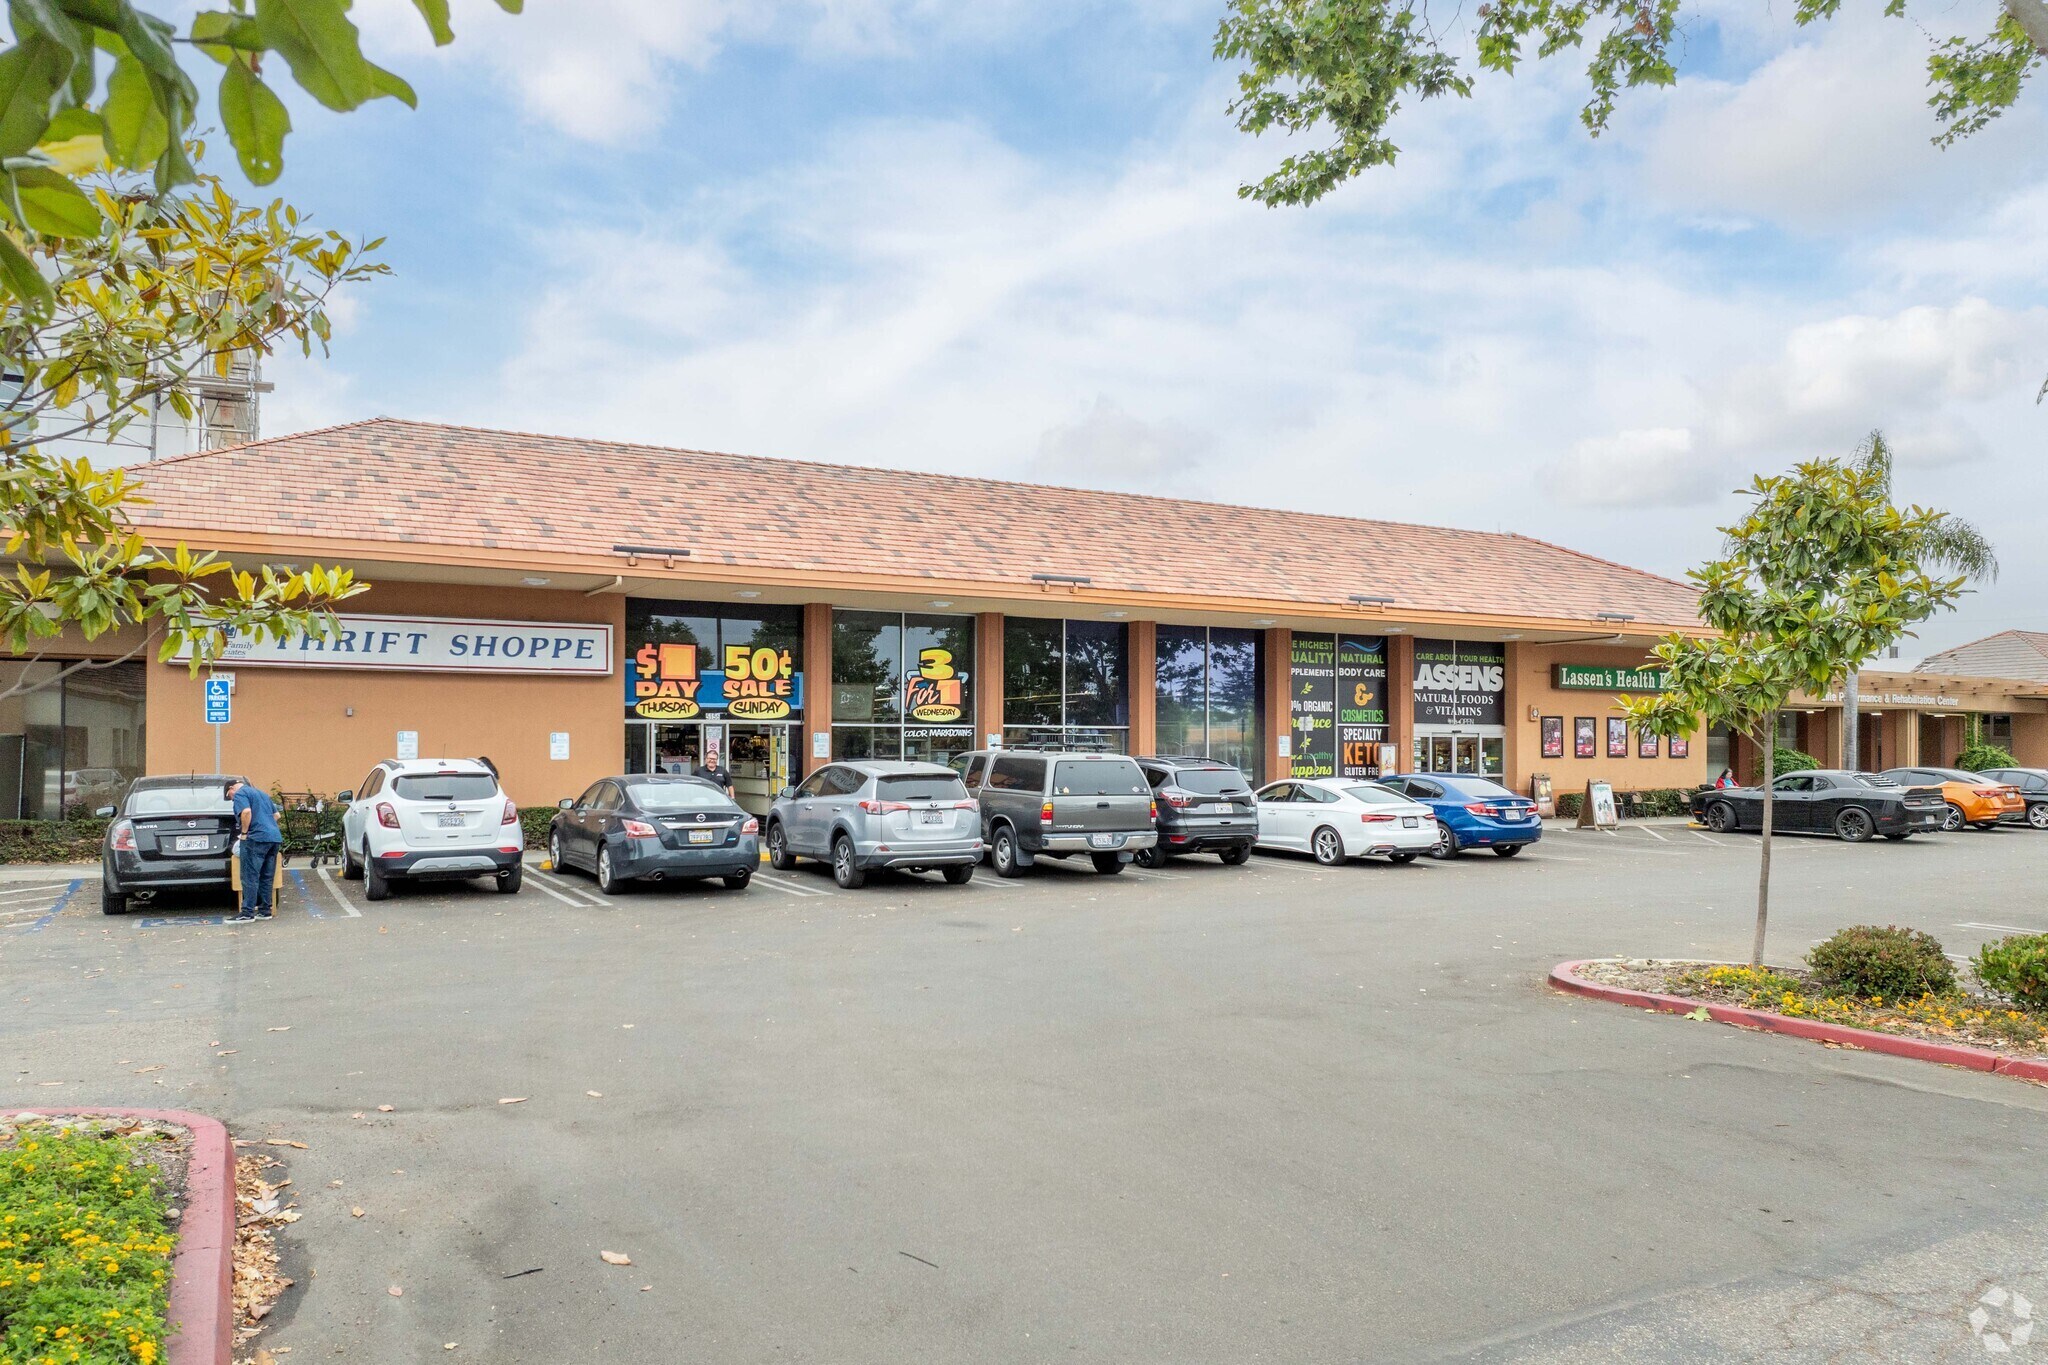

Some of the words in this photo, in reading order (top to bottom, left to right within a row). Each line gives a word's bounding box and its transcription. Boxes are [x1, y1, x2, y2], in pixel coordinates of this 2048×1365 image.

[227, 641, 254, 652] Family
[450, 635, 595, 659] SHOPPE
[1299, 640, 1334, 650] HIGHEST
[636, 643, 696, 680] $1
[725, 645, 792, 681] 50¢
[1291, 651, 1333, 664] UALITY
[1340, 653, 1384, 664] NATURAL
[920, 649, 954, 680] 3
[1291, 668, 1335, 677] PPLEMENTS
[1338, 667, 1362, 677] BODY
[1363, 668, 1386, 678] CARE
[1561, 667, 1612, 687] Lassen's
[1616, 670, 1656, 689] Health
[636, 681, 700, 697] DAY
[723, 680, 793, 697] SALE
[905, 677, 939, 709] For
[936, 680, 961, 704] 1
[1354, 682, 1374, 707] &
[208, 694, 228, 702] PARKING
[1414, 693, 1460, 703] NATURAL
[1461, 695, 1494, 704] FOODS
[1821, 692, 1837, 702] lite
[1838, 691, 1883, 703] Prmance
[1884, 694, 1890, 703] &
[1892, 694, 1936, 705] Rehabilitation
[1937, 696, 1959, 706] Center
[640, 701, 693, 714] THURSDAY
[733, 701, 783, 714] SUNDAY
[916, 708, 956, 716] WEDNESDAY
[1303, 700, 1333, 713] ORGANIC
[1425, 706, 1434, 715] &
[1434, 706, 1482, 716] VITAMINS
[1341, 709, 1384, 722] COSMETICS
[904, 729, 928, 738] COLOR
[929, 728, 973, 737] MARKDOWNS
[1343, 728, 1382, 741] SPECIALTY
[1291, 765, 1333, 778] appens
[1344, 767, 1367, 776] GLUTEN
[1368, 767, 1379, 776] FRE
